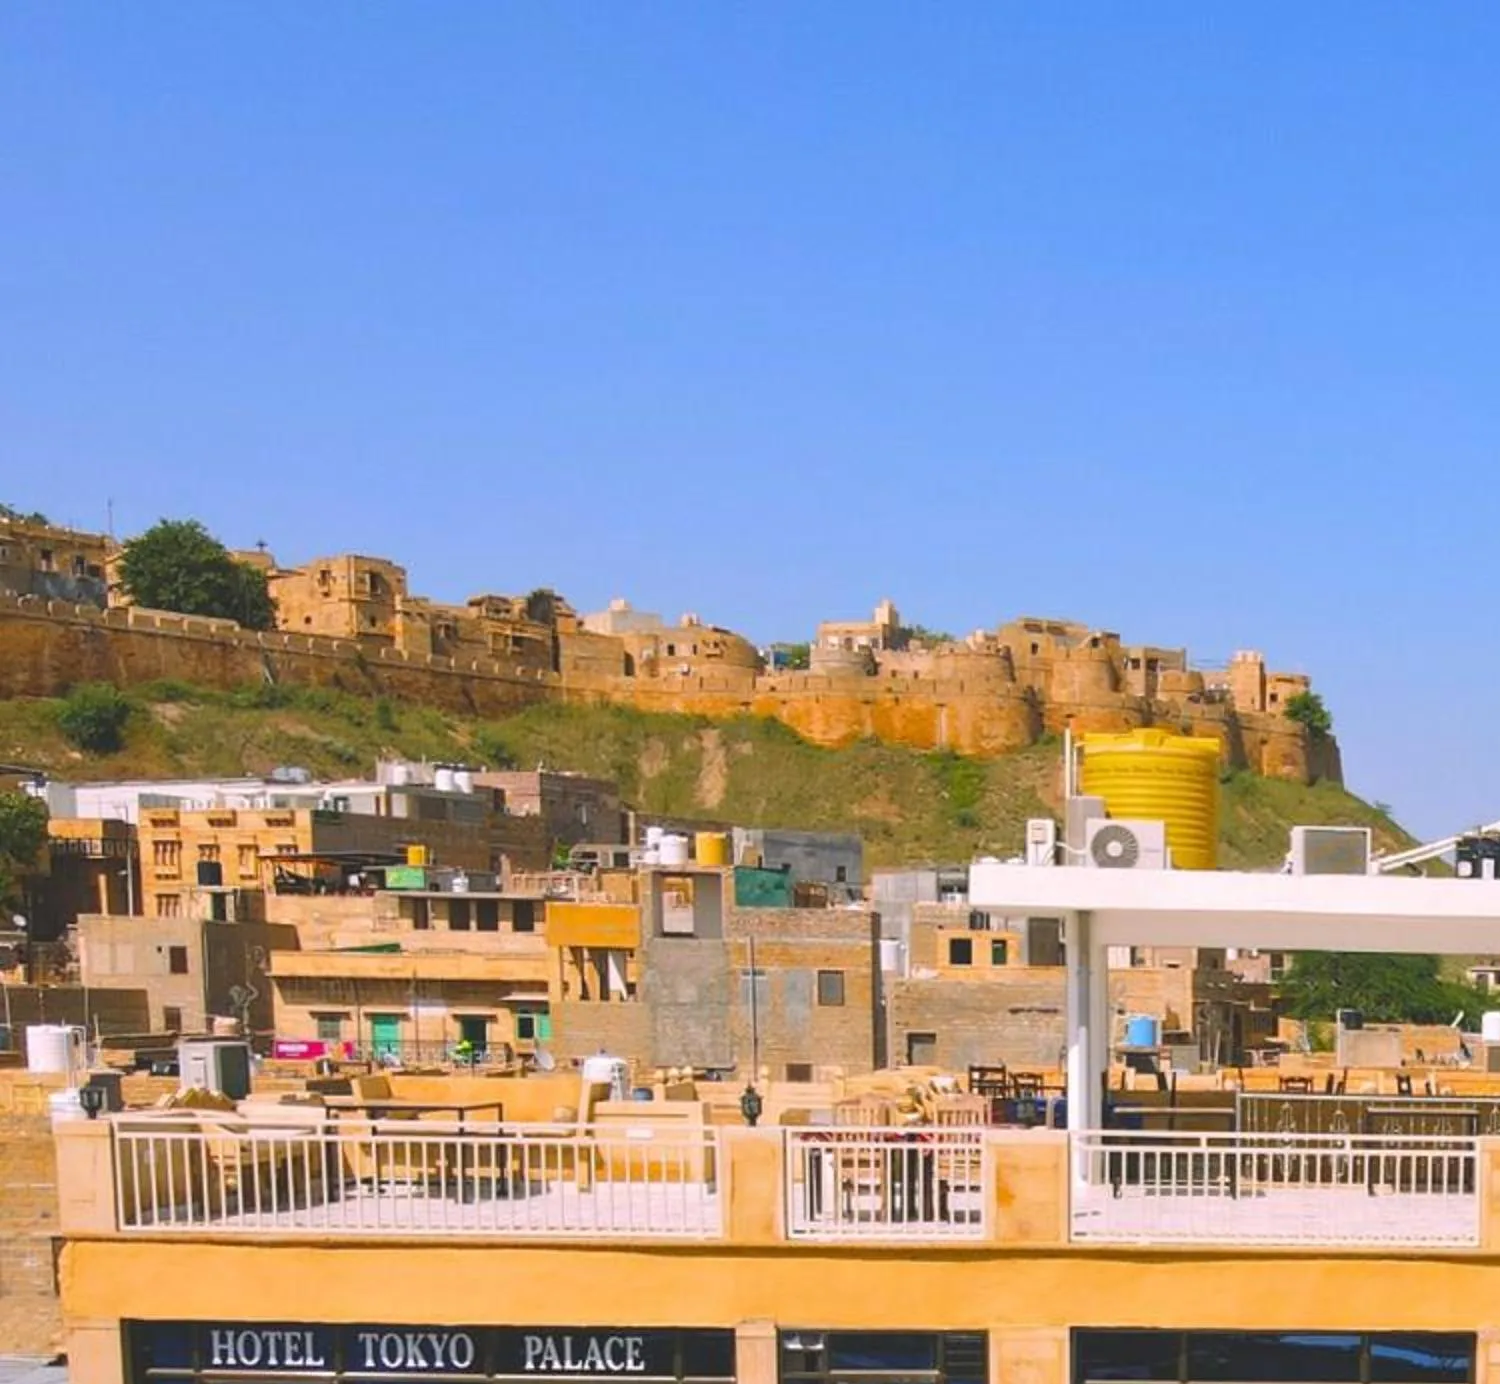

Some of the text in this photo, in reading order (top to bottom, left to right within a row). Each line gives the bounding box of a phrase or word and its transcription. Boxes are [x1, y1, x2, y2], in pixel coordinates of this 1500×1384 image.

[211, 1330, 646, 1372] HOTEL TOKYO PALACE
